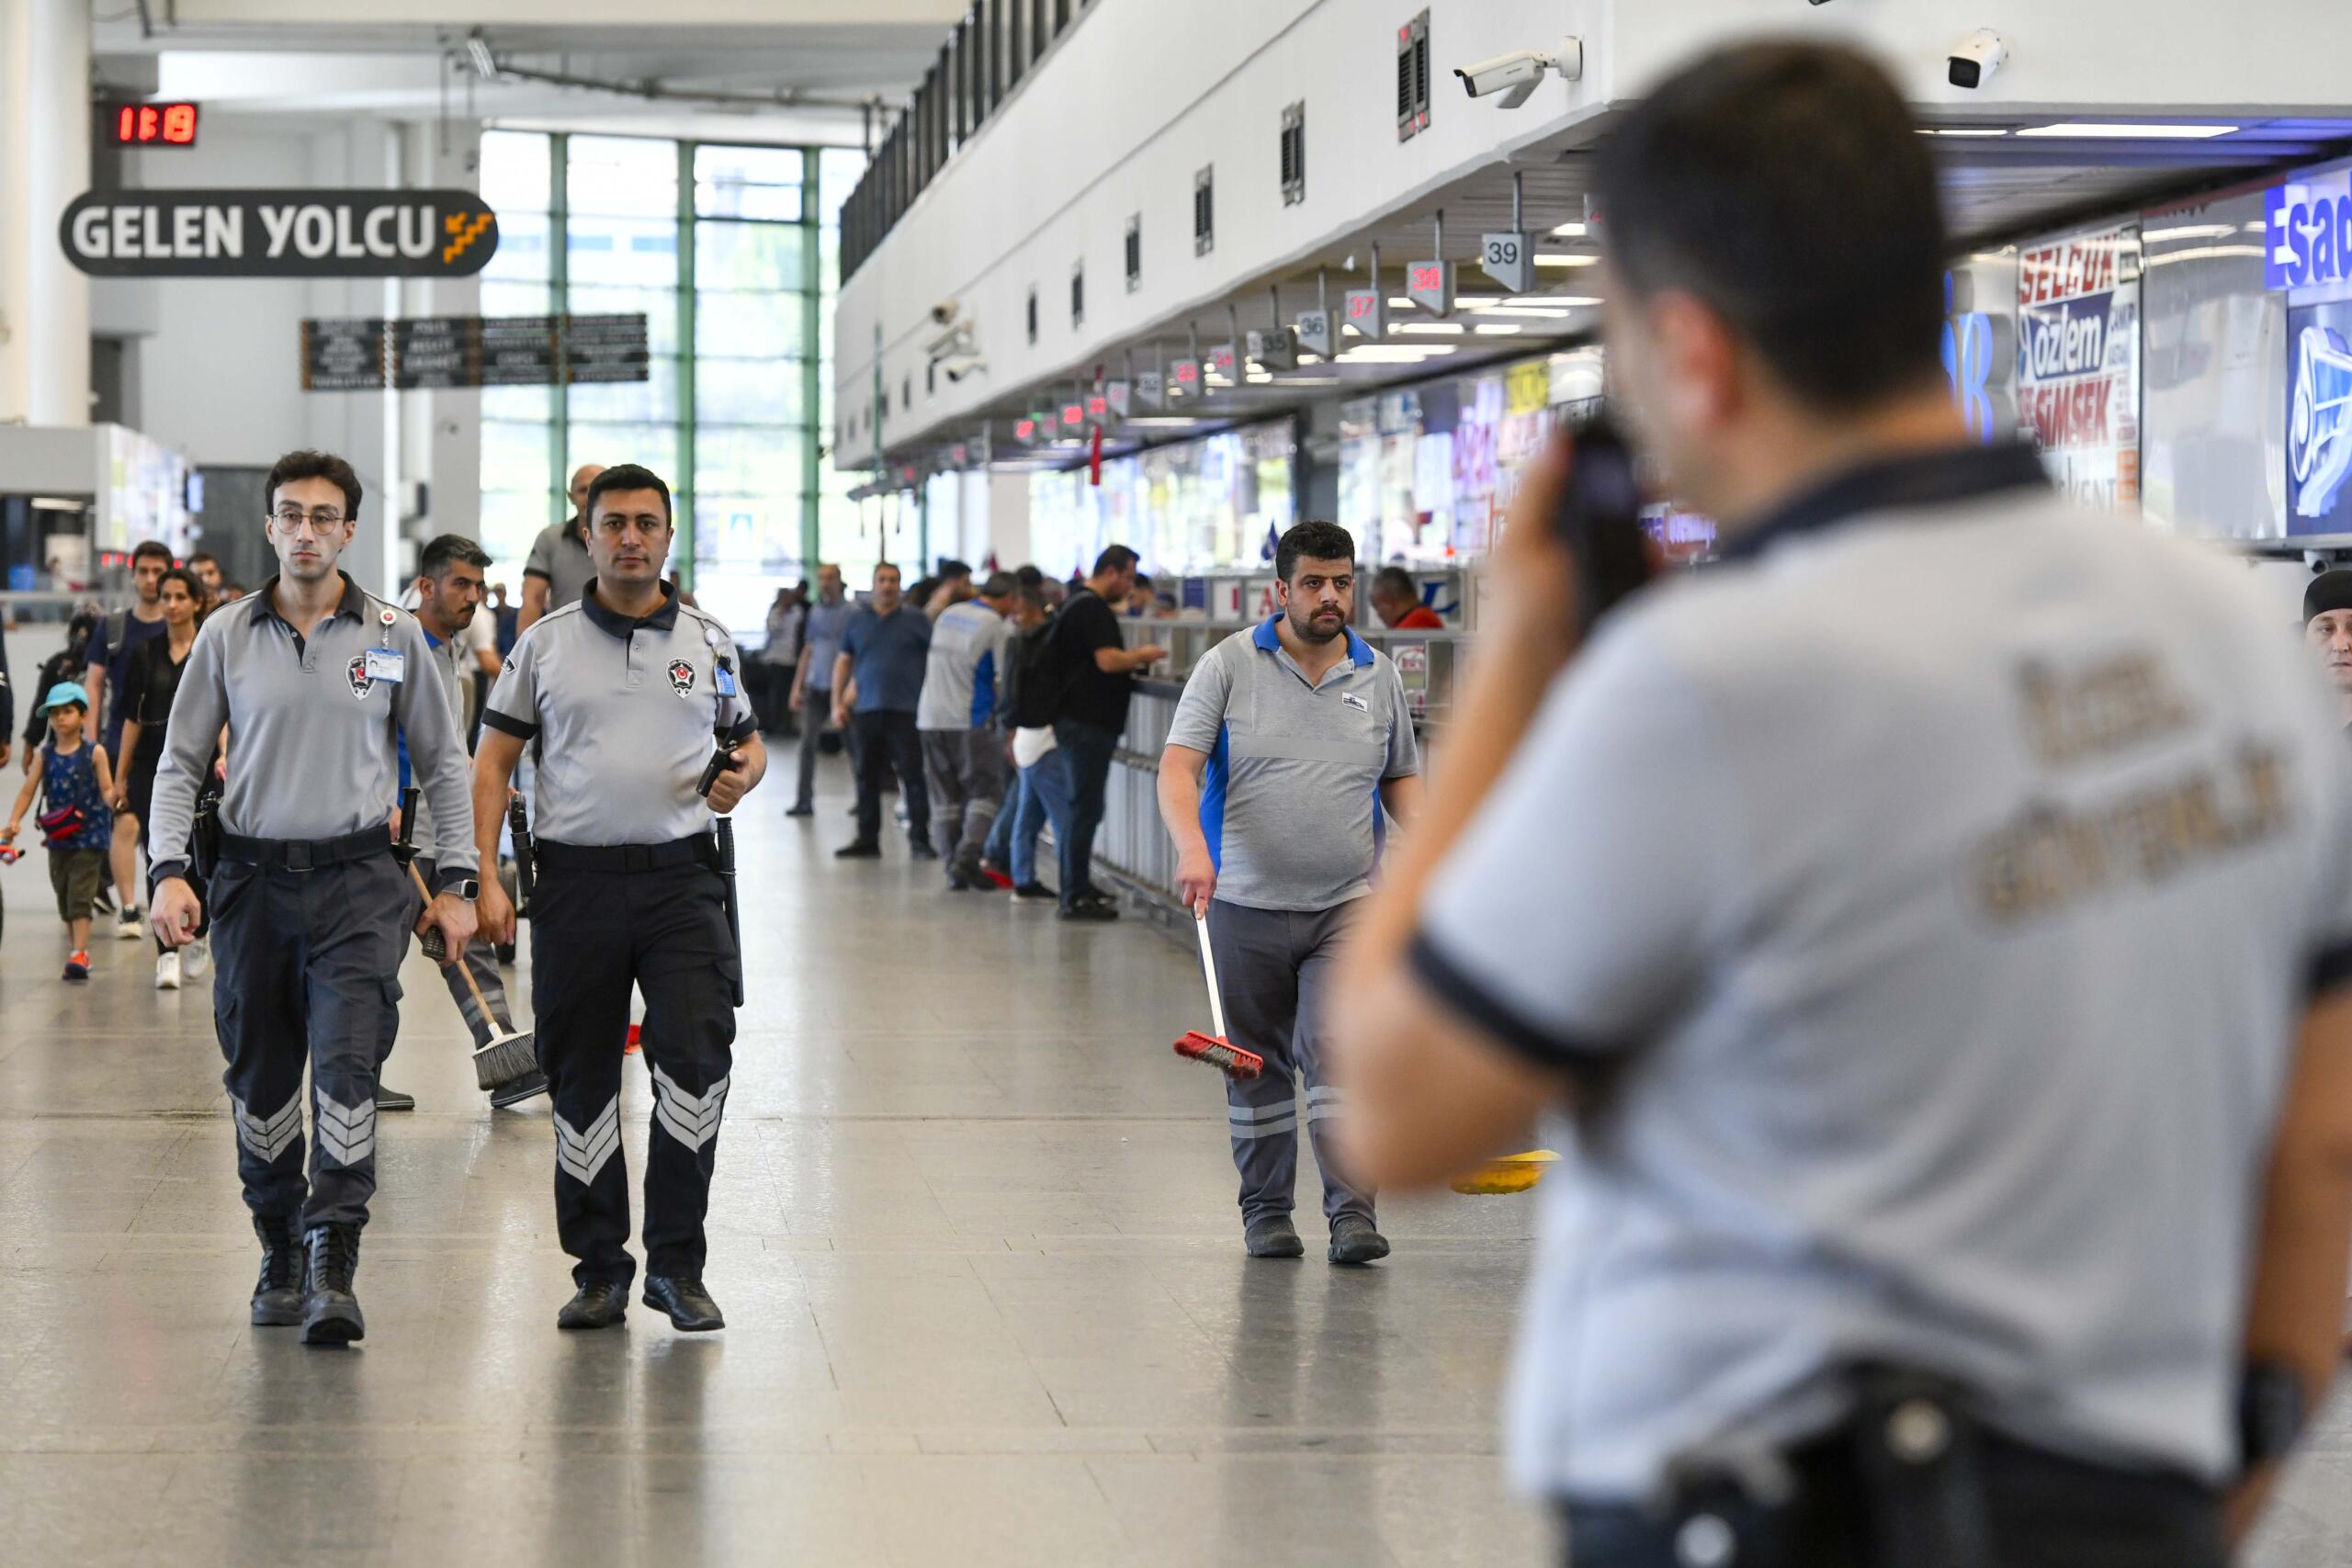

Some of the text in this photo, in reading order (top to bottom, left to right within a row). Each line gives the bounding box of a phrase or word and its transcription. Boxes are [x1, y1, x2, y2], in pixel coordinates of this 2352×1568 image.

[72, 206, 436, 258] GELEN YOLCU
[1487, 242, 1518, 265] 39
[1411, 266, 1442, 291] 38
[1349, 295, 1375, 318] 37
